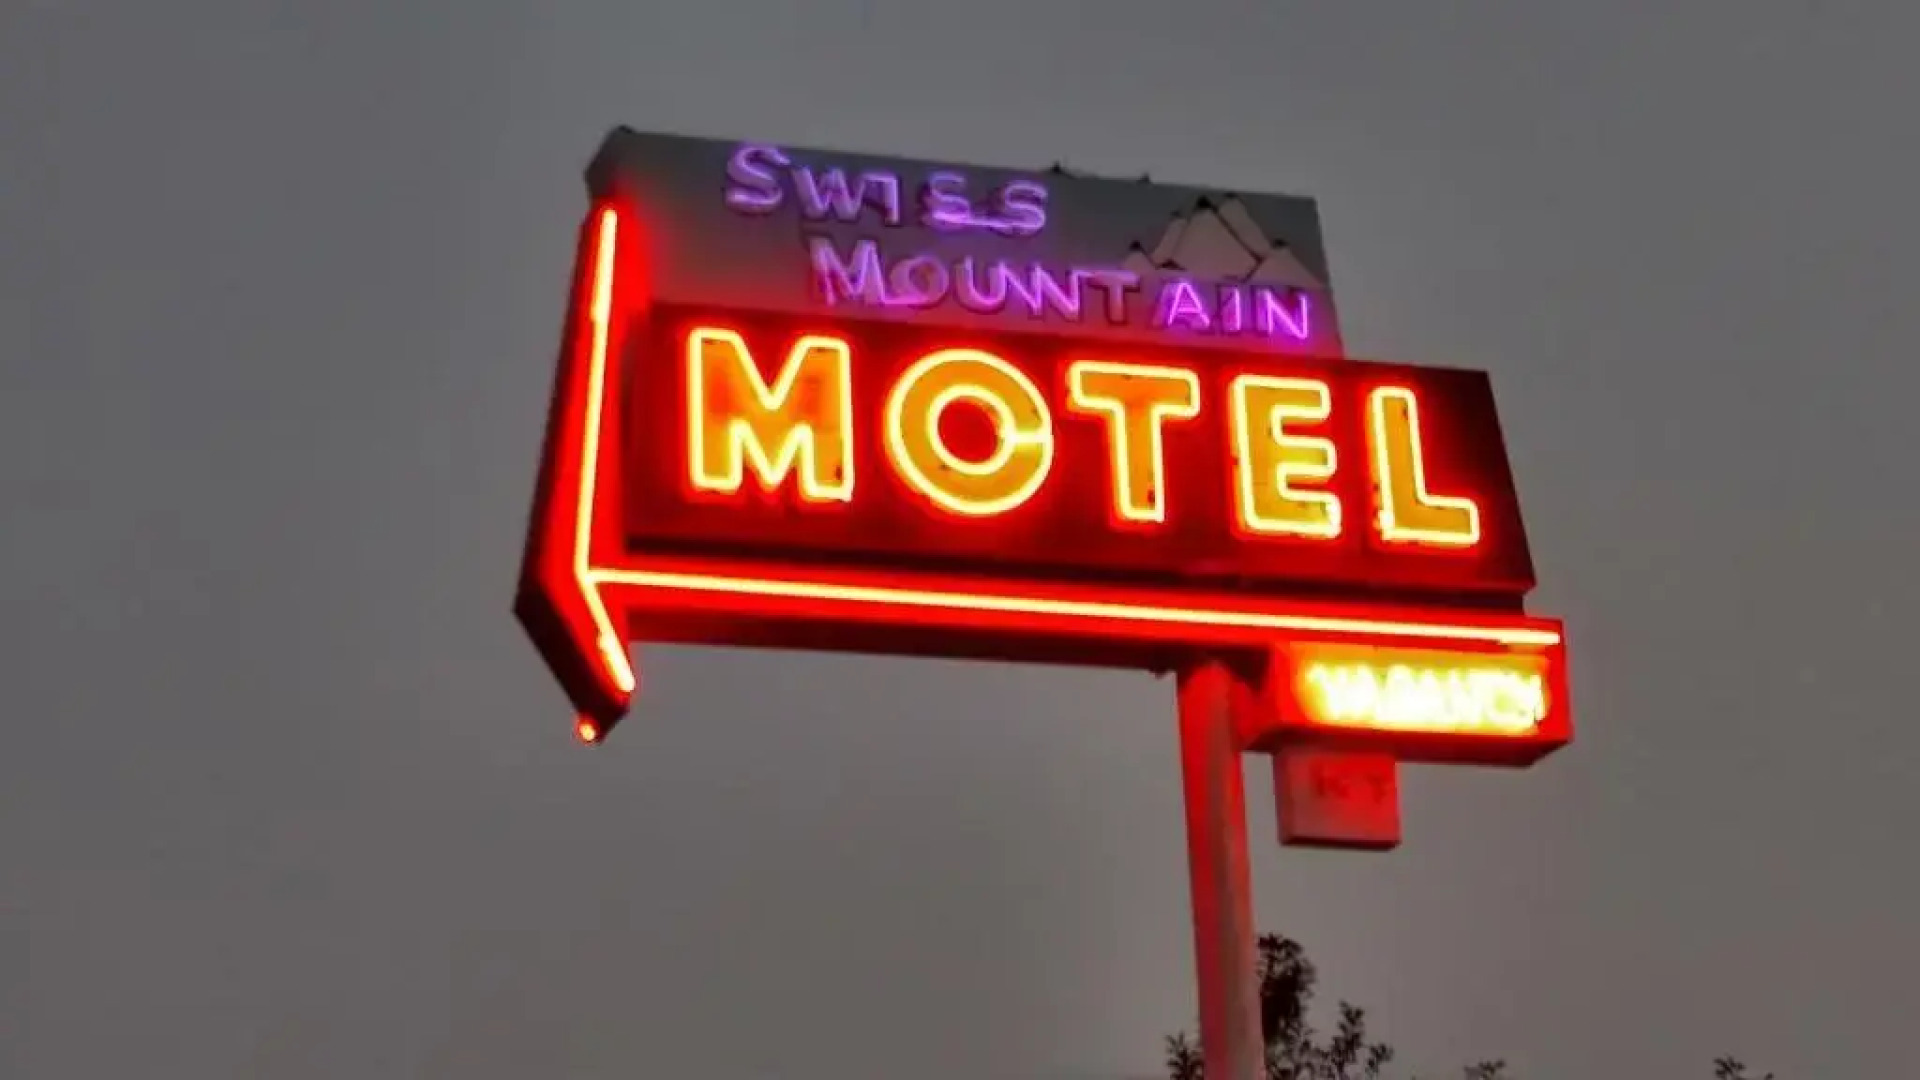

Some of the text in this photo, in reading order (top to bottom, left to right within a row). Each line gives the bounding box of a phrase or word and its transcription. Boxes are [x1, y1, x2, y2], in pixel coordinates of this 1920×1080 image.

[725, 144, 1049, 235] SWISS
[809, 236, 1315, 341] MOUNTAIN
[686, 327, 1481, 546] MOTEL
